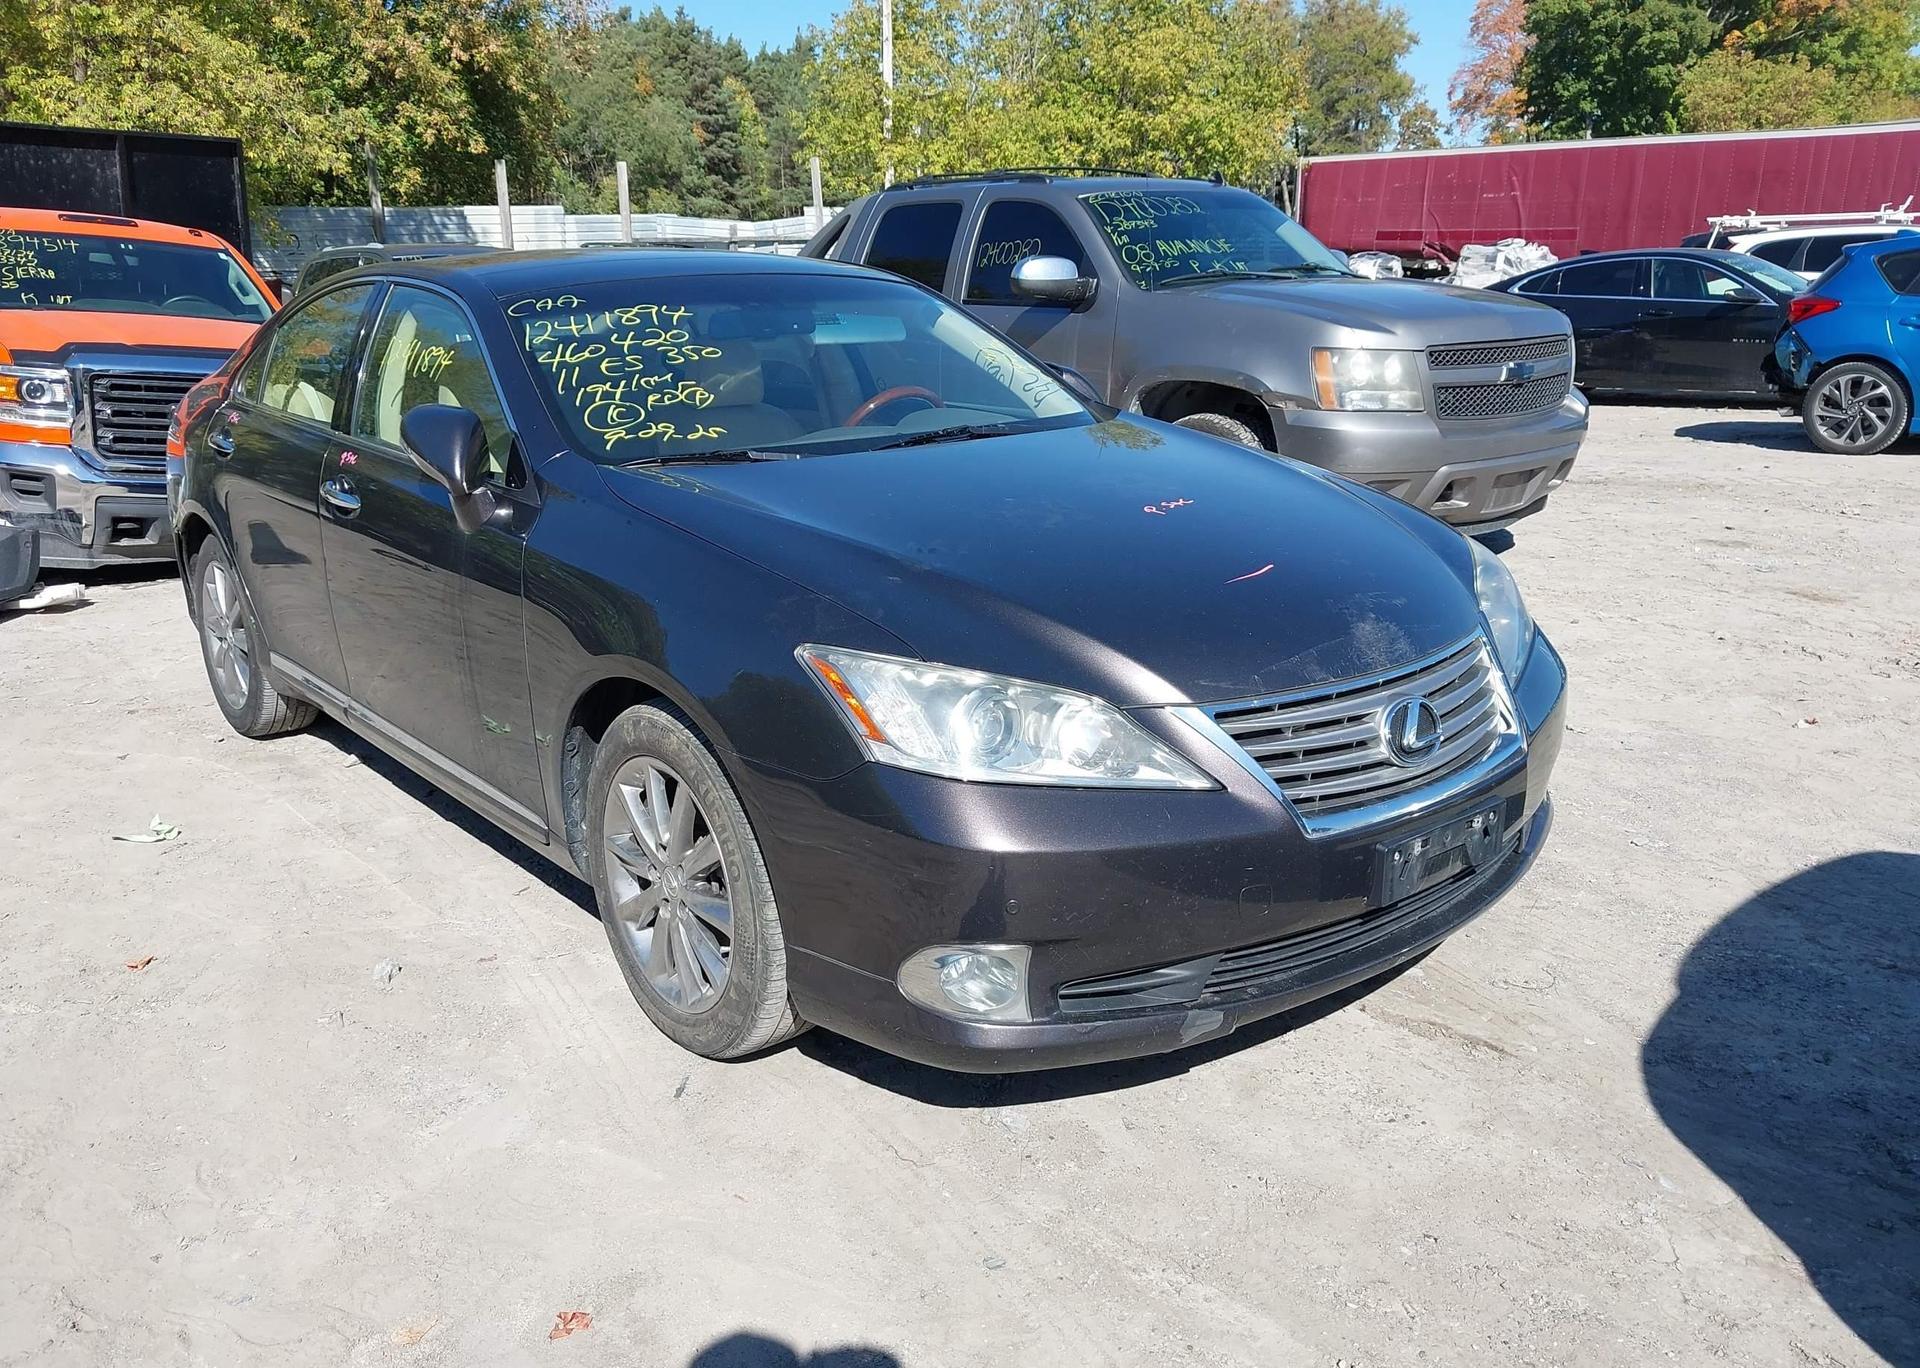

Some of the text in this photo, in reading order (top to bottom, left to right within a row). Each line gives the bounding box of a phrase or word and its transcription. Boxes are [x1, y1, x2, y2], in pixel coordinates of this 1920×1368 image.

[508, 295, 586, 316] CAA
[525, 304, 694, 351] 12411894
[537, 328, 690, 372] 460 420
[557, 345, 722, 394] 11 ES 350
